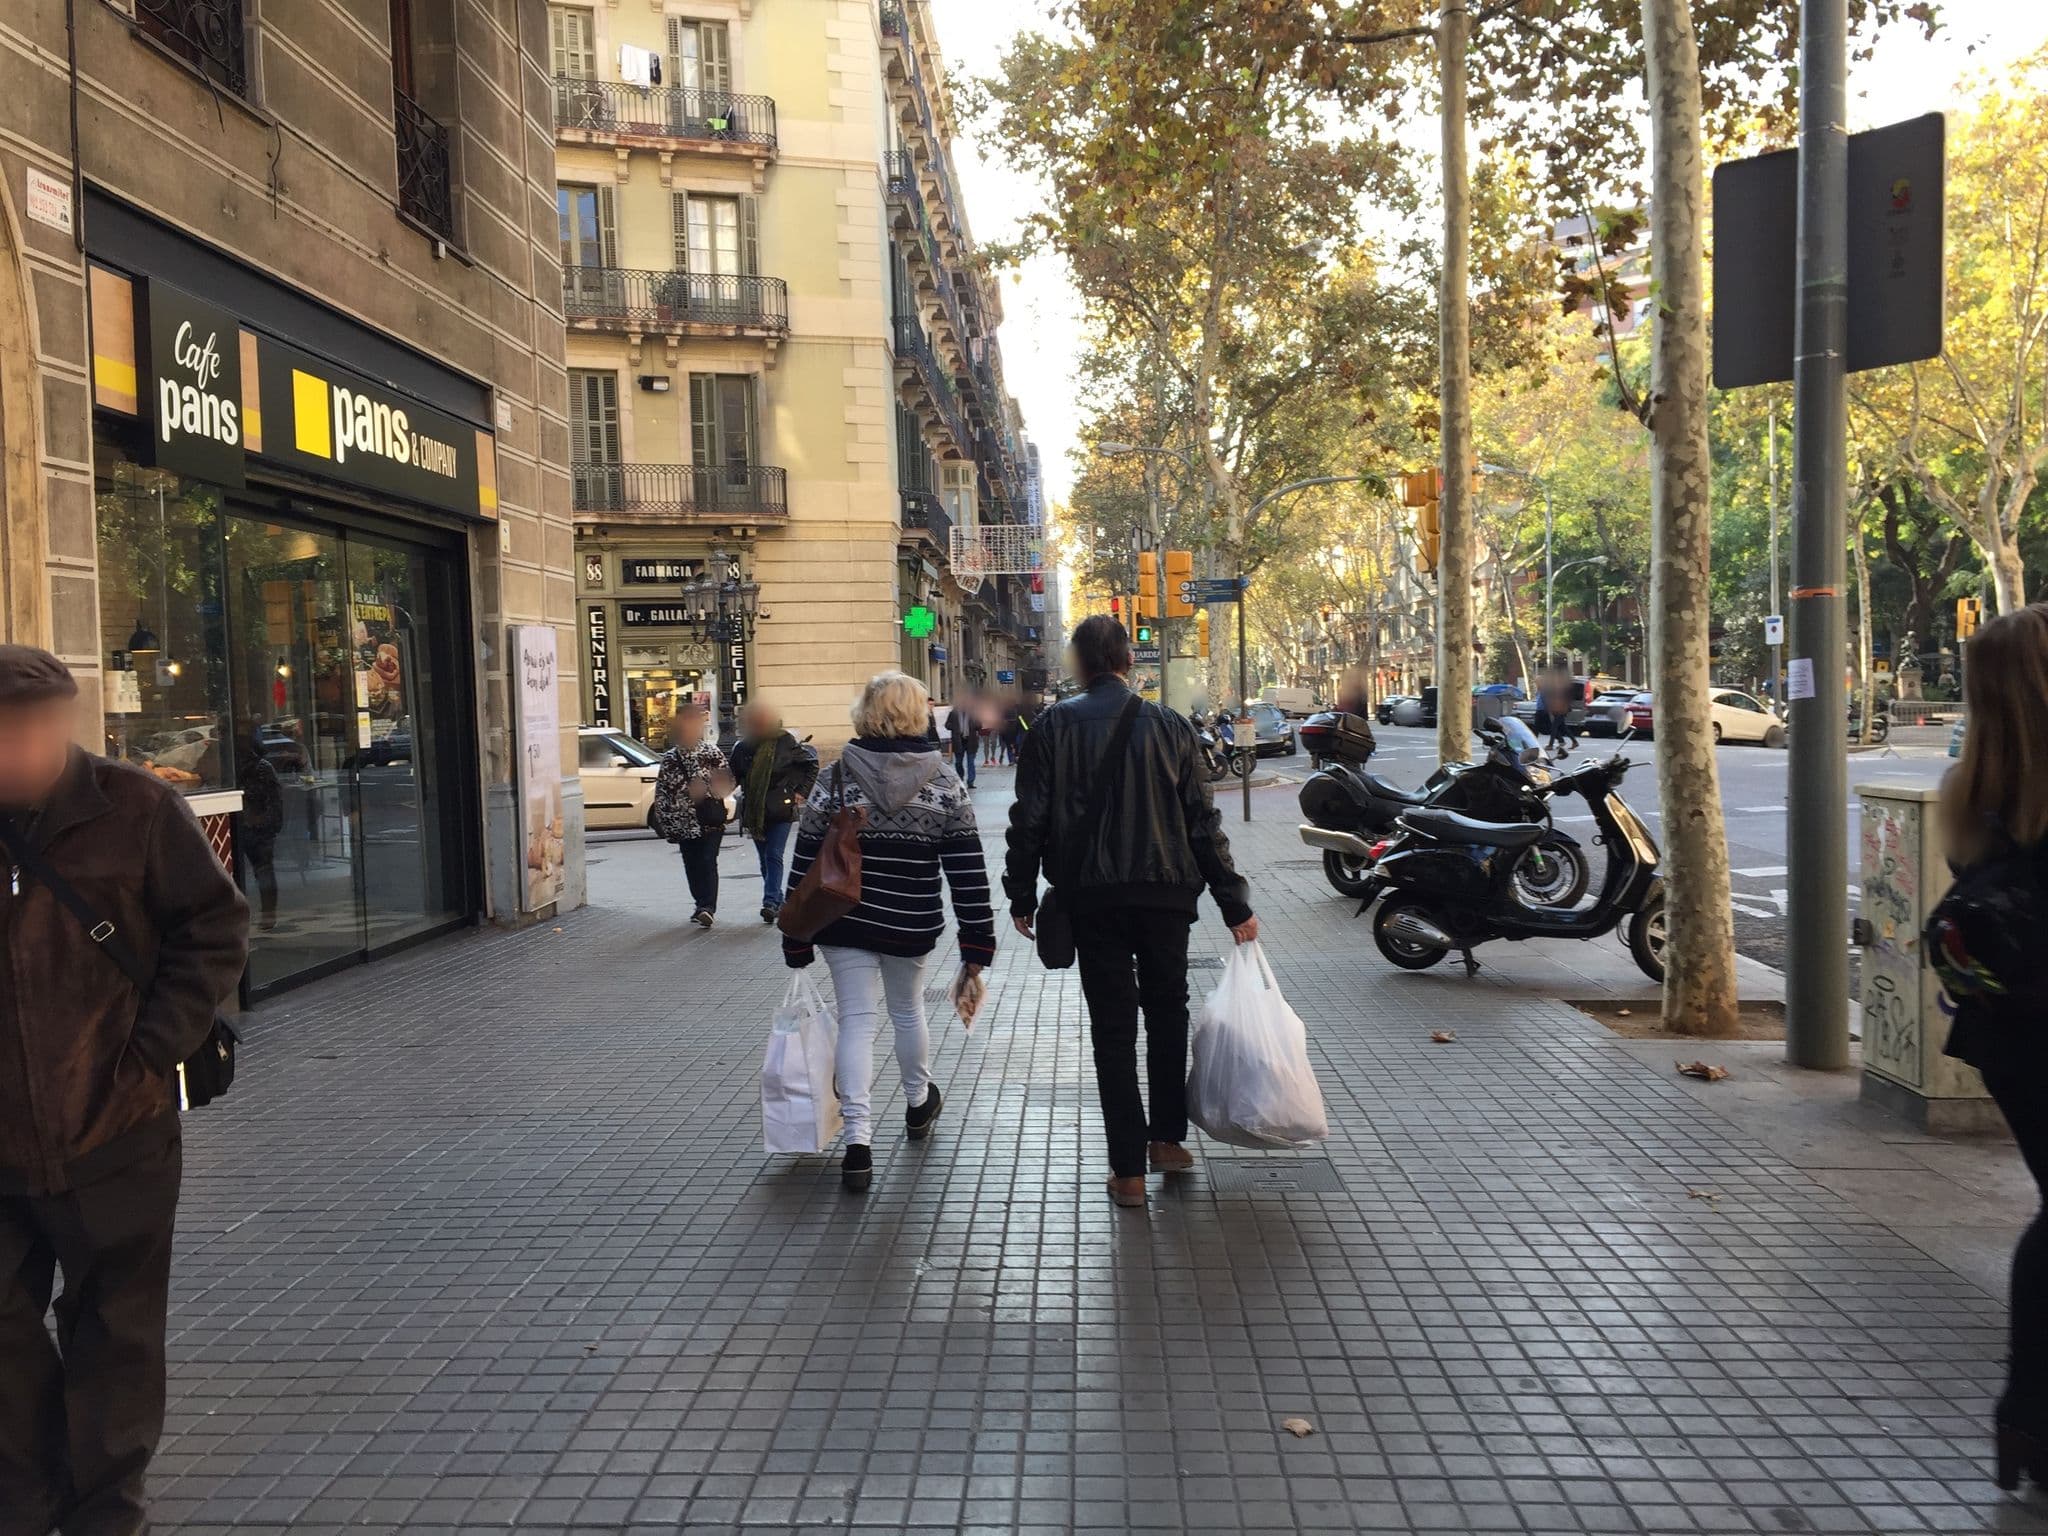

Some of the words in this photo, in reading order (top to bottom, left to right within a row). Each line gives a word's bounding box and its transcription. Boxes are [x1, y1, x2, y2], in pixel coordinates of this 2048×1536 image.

[159, 376, 239, 446] pans
[332, 384, 411, 464] pans
[411, 432, 420, 467] &
[419, 435, 457, 479] COMPANY
[586, 563, 603, 581] 88
[626, 610, 645, 622] Dr.
[590, 611, 608, 711] CENTRAL
